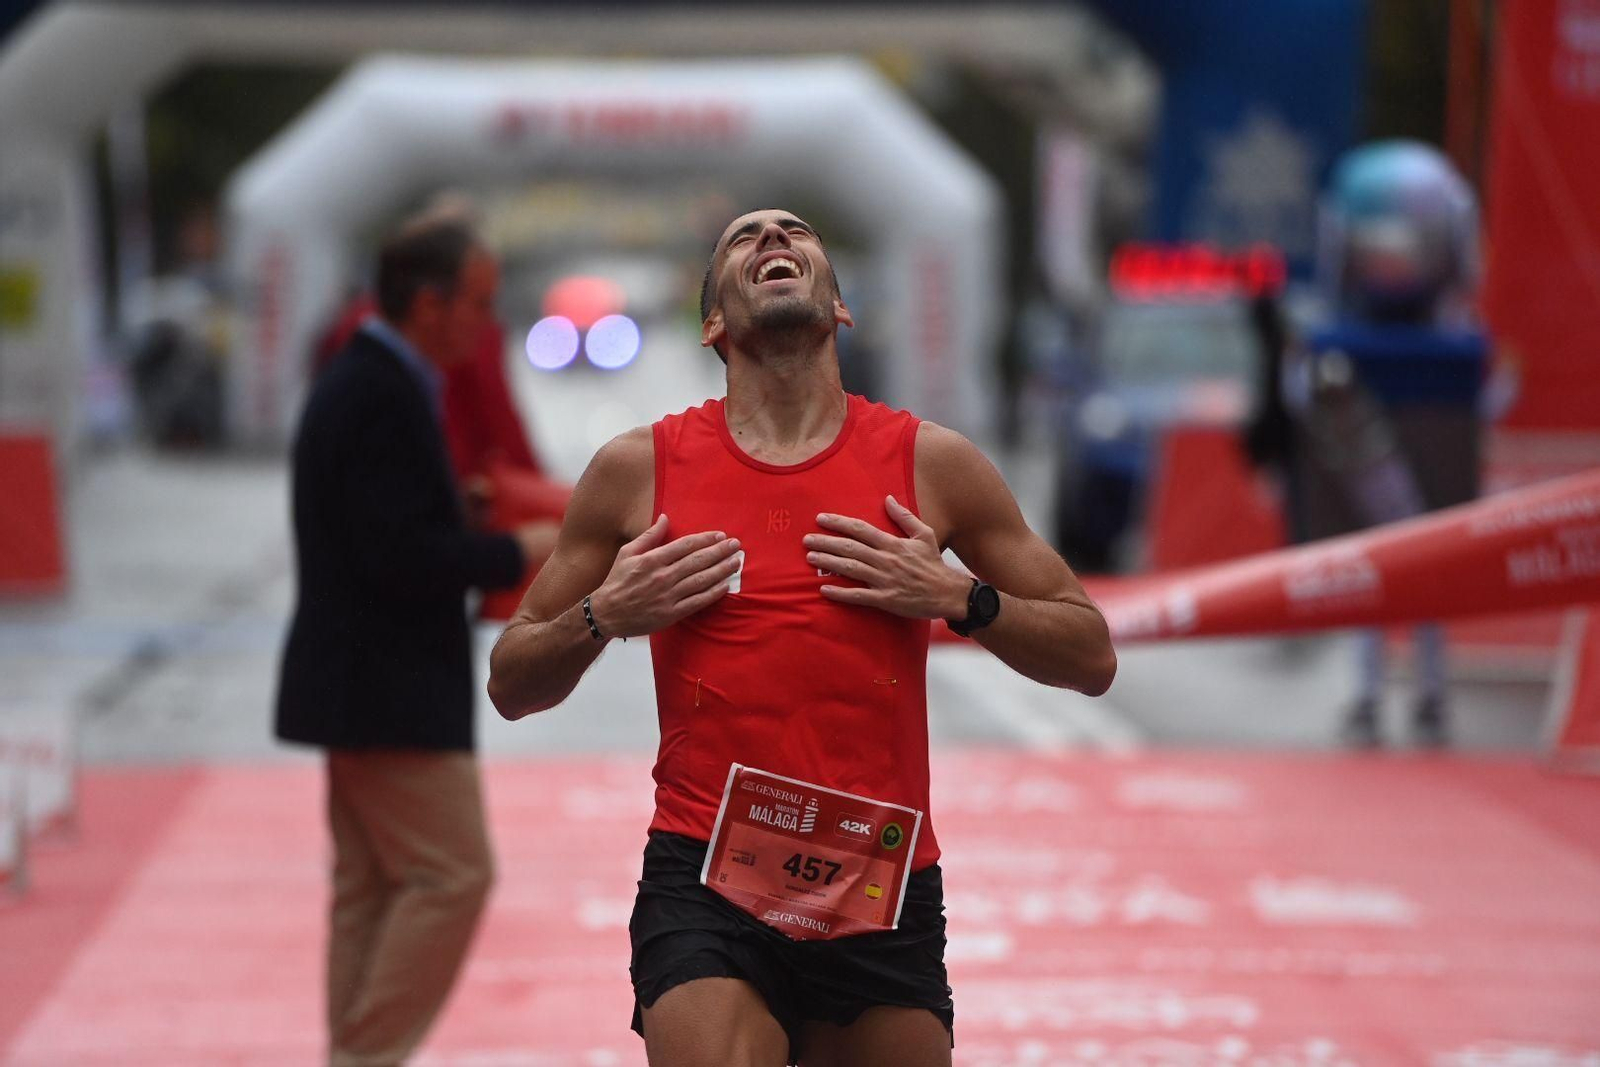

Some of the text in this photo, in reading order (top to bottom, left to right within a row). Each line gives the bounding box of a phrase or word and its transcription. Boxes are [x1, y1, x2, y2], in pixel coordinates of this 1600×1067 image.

[755, 783, 803, 805] GENERALI
[748, 804, 798, 832] MÁLAGA
[839, 819, 871, 836] 42K
[782, 853, 842, 886] 457
[780, 912, 831, 934] GENERALI
